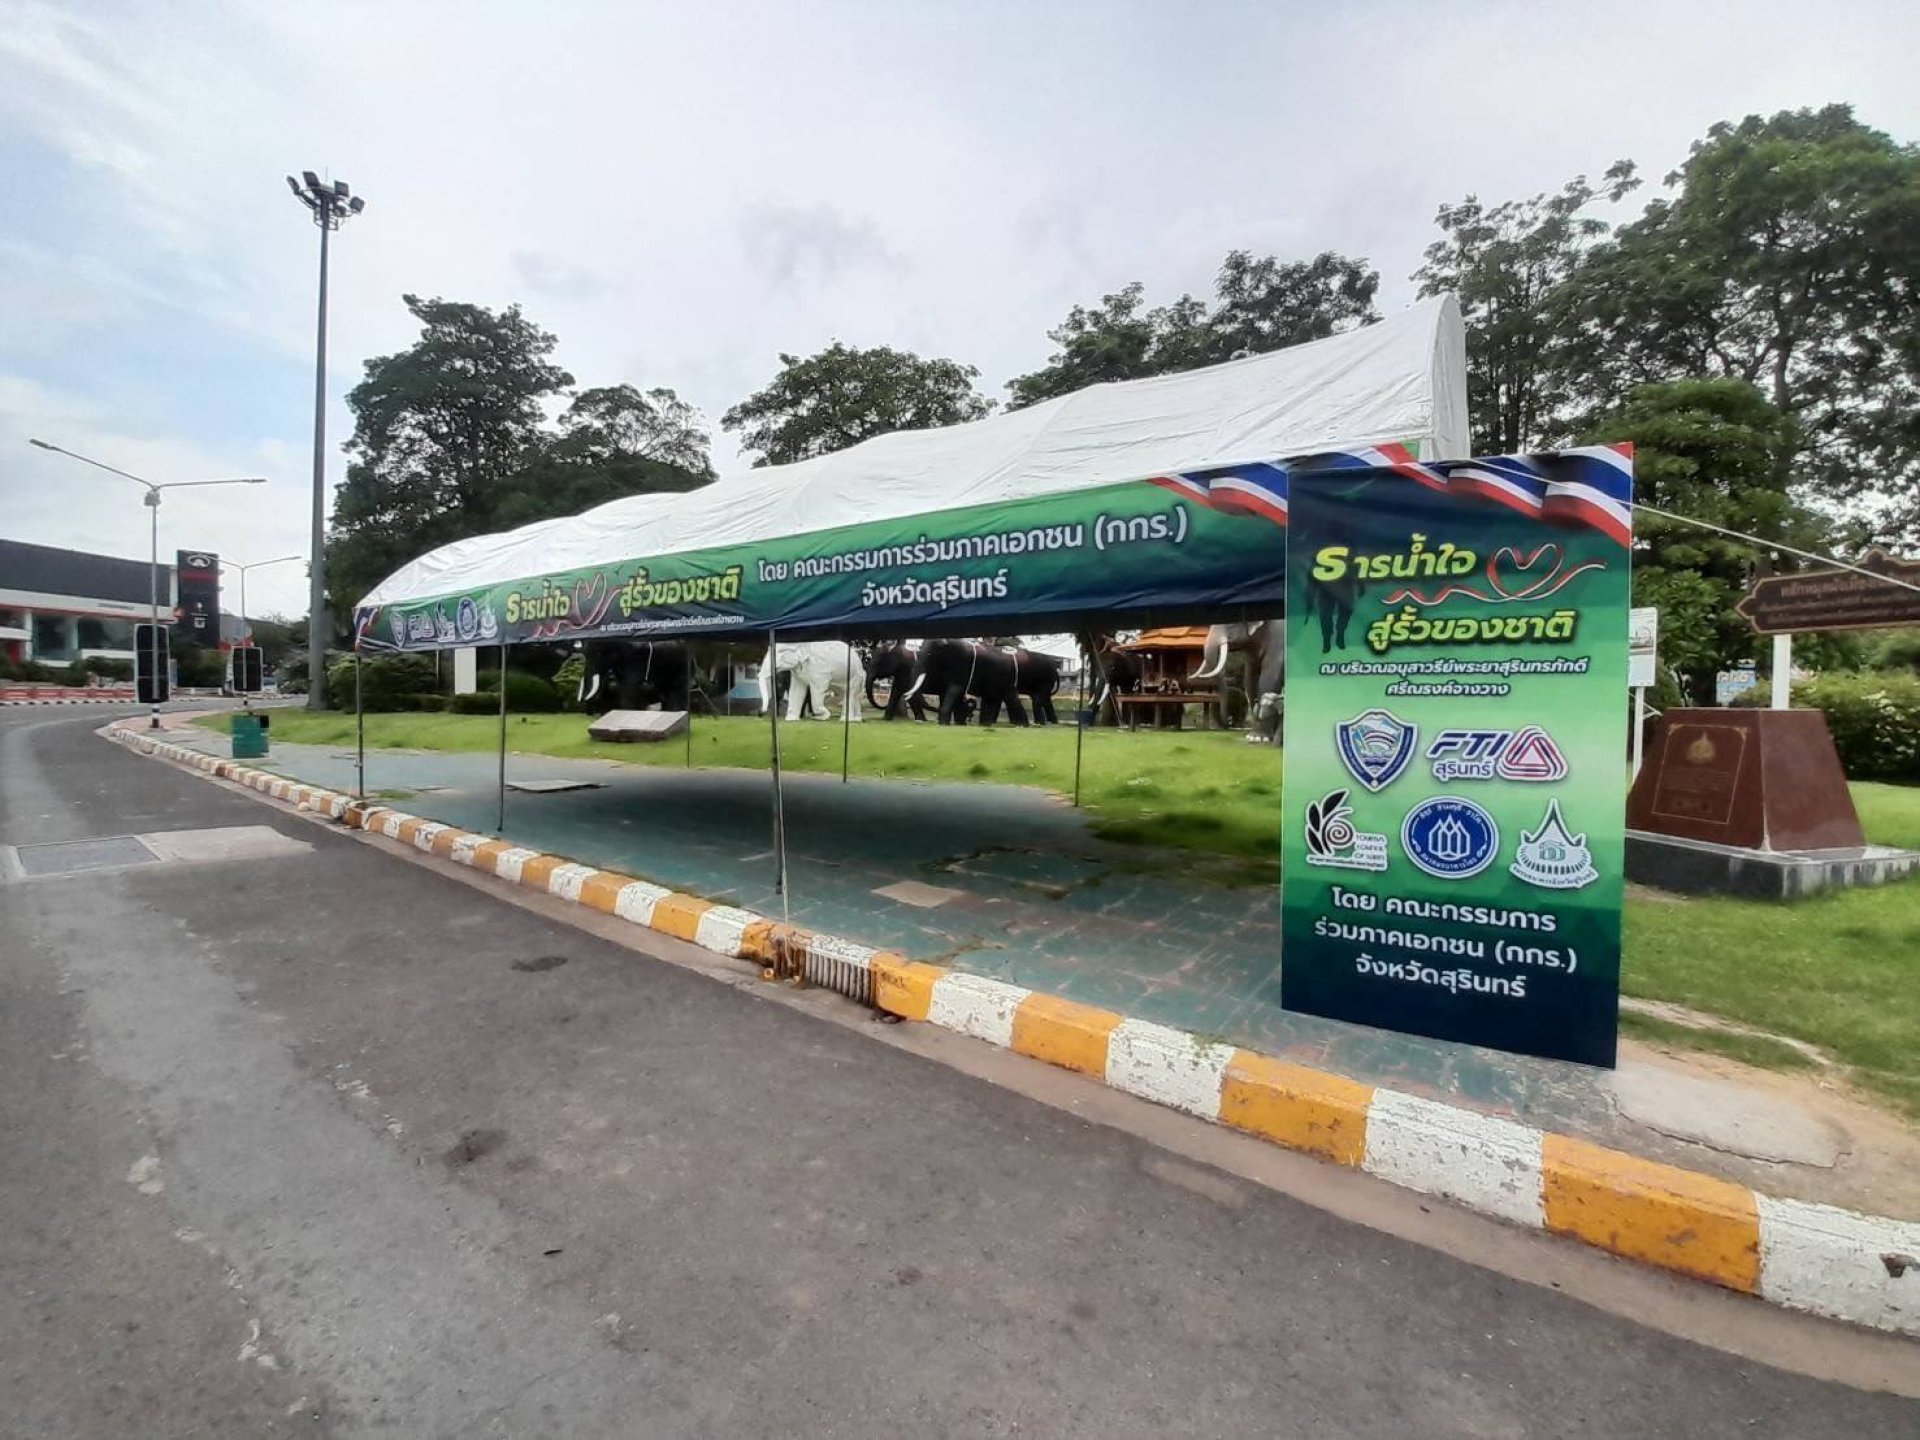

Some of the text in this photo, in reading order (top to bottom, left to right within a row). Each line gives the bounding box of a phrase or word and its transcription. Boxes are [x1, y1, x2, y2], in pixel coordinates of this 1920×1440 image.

[759, 506, 1188, 582] โดย คณะกรรมการร่วมภาคเอกชน (กกร.)
[619, 566, 742, 617] สู่รั้วของชาติ
[862, 569, 1008, 609] จังหวัดสุรินทร์
[1366, 605, 1576, 650] สู่รั้วของชาติ
[1427, 732, 1509, 756] FTI
[1434, 759, 1491, 780] สุรินทร์
[1332, 887, 1557, 932] โดย คณะกรรมการ
[1314, 918, 1577, 973] ร่วมภาคเอกชน (กกร.)
[1356, 953, 1527, 998] จังหวัดสุรินทร์
